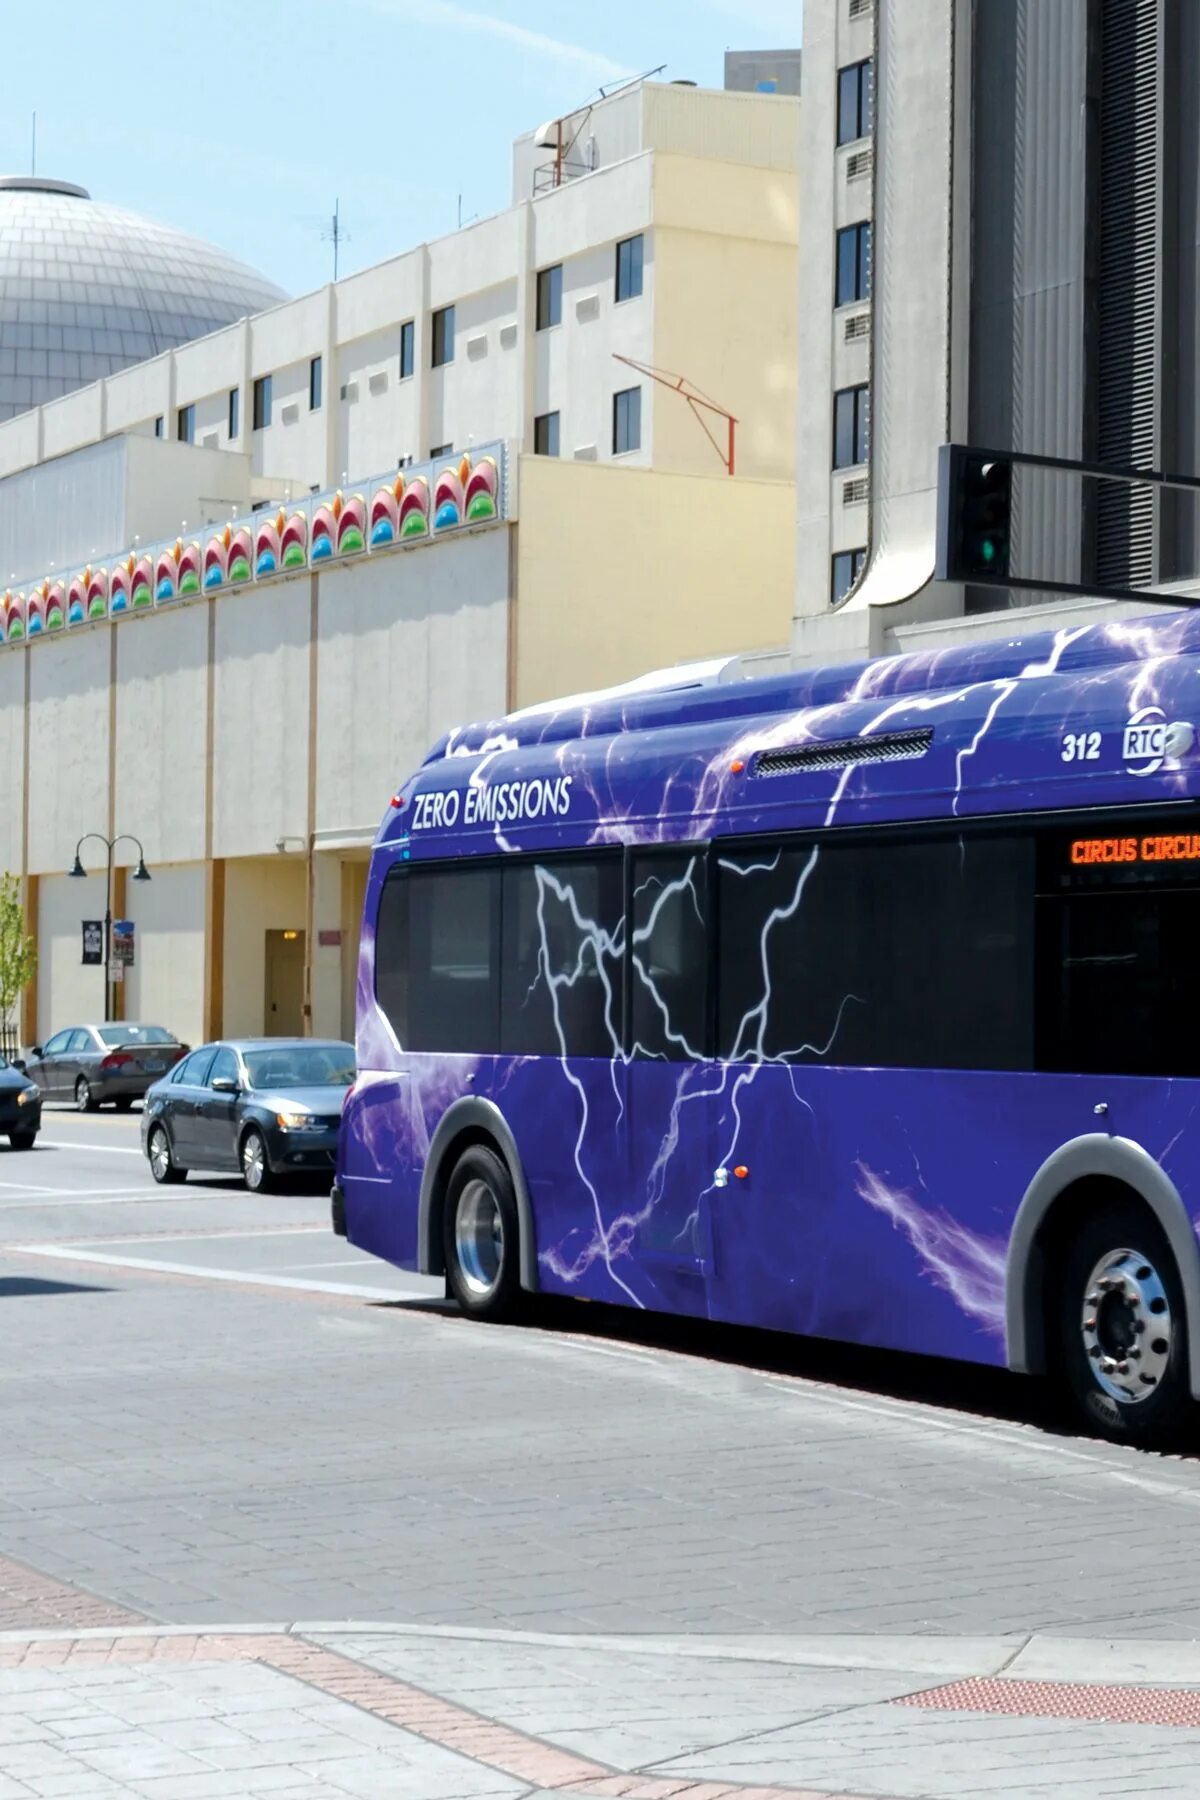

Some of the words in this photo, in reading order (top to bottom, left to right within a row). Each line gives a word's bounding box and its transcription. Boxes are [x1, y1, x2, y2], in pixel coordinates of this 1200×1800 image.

[1061, 731, 1102, 762] 312
[1127, 728, 1162, 754] RTC
[411, 790, 459, 830] ZERO
[464, 776, 573, 824] EMISSIONS
[1071, 837, 1138, 864] CIRCUS
